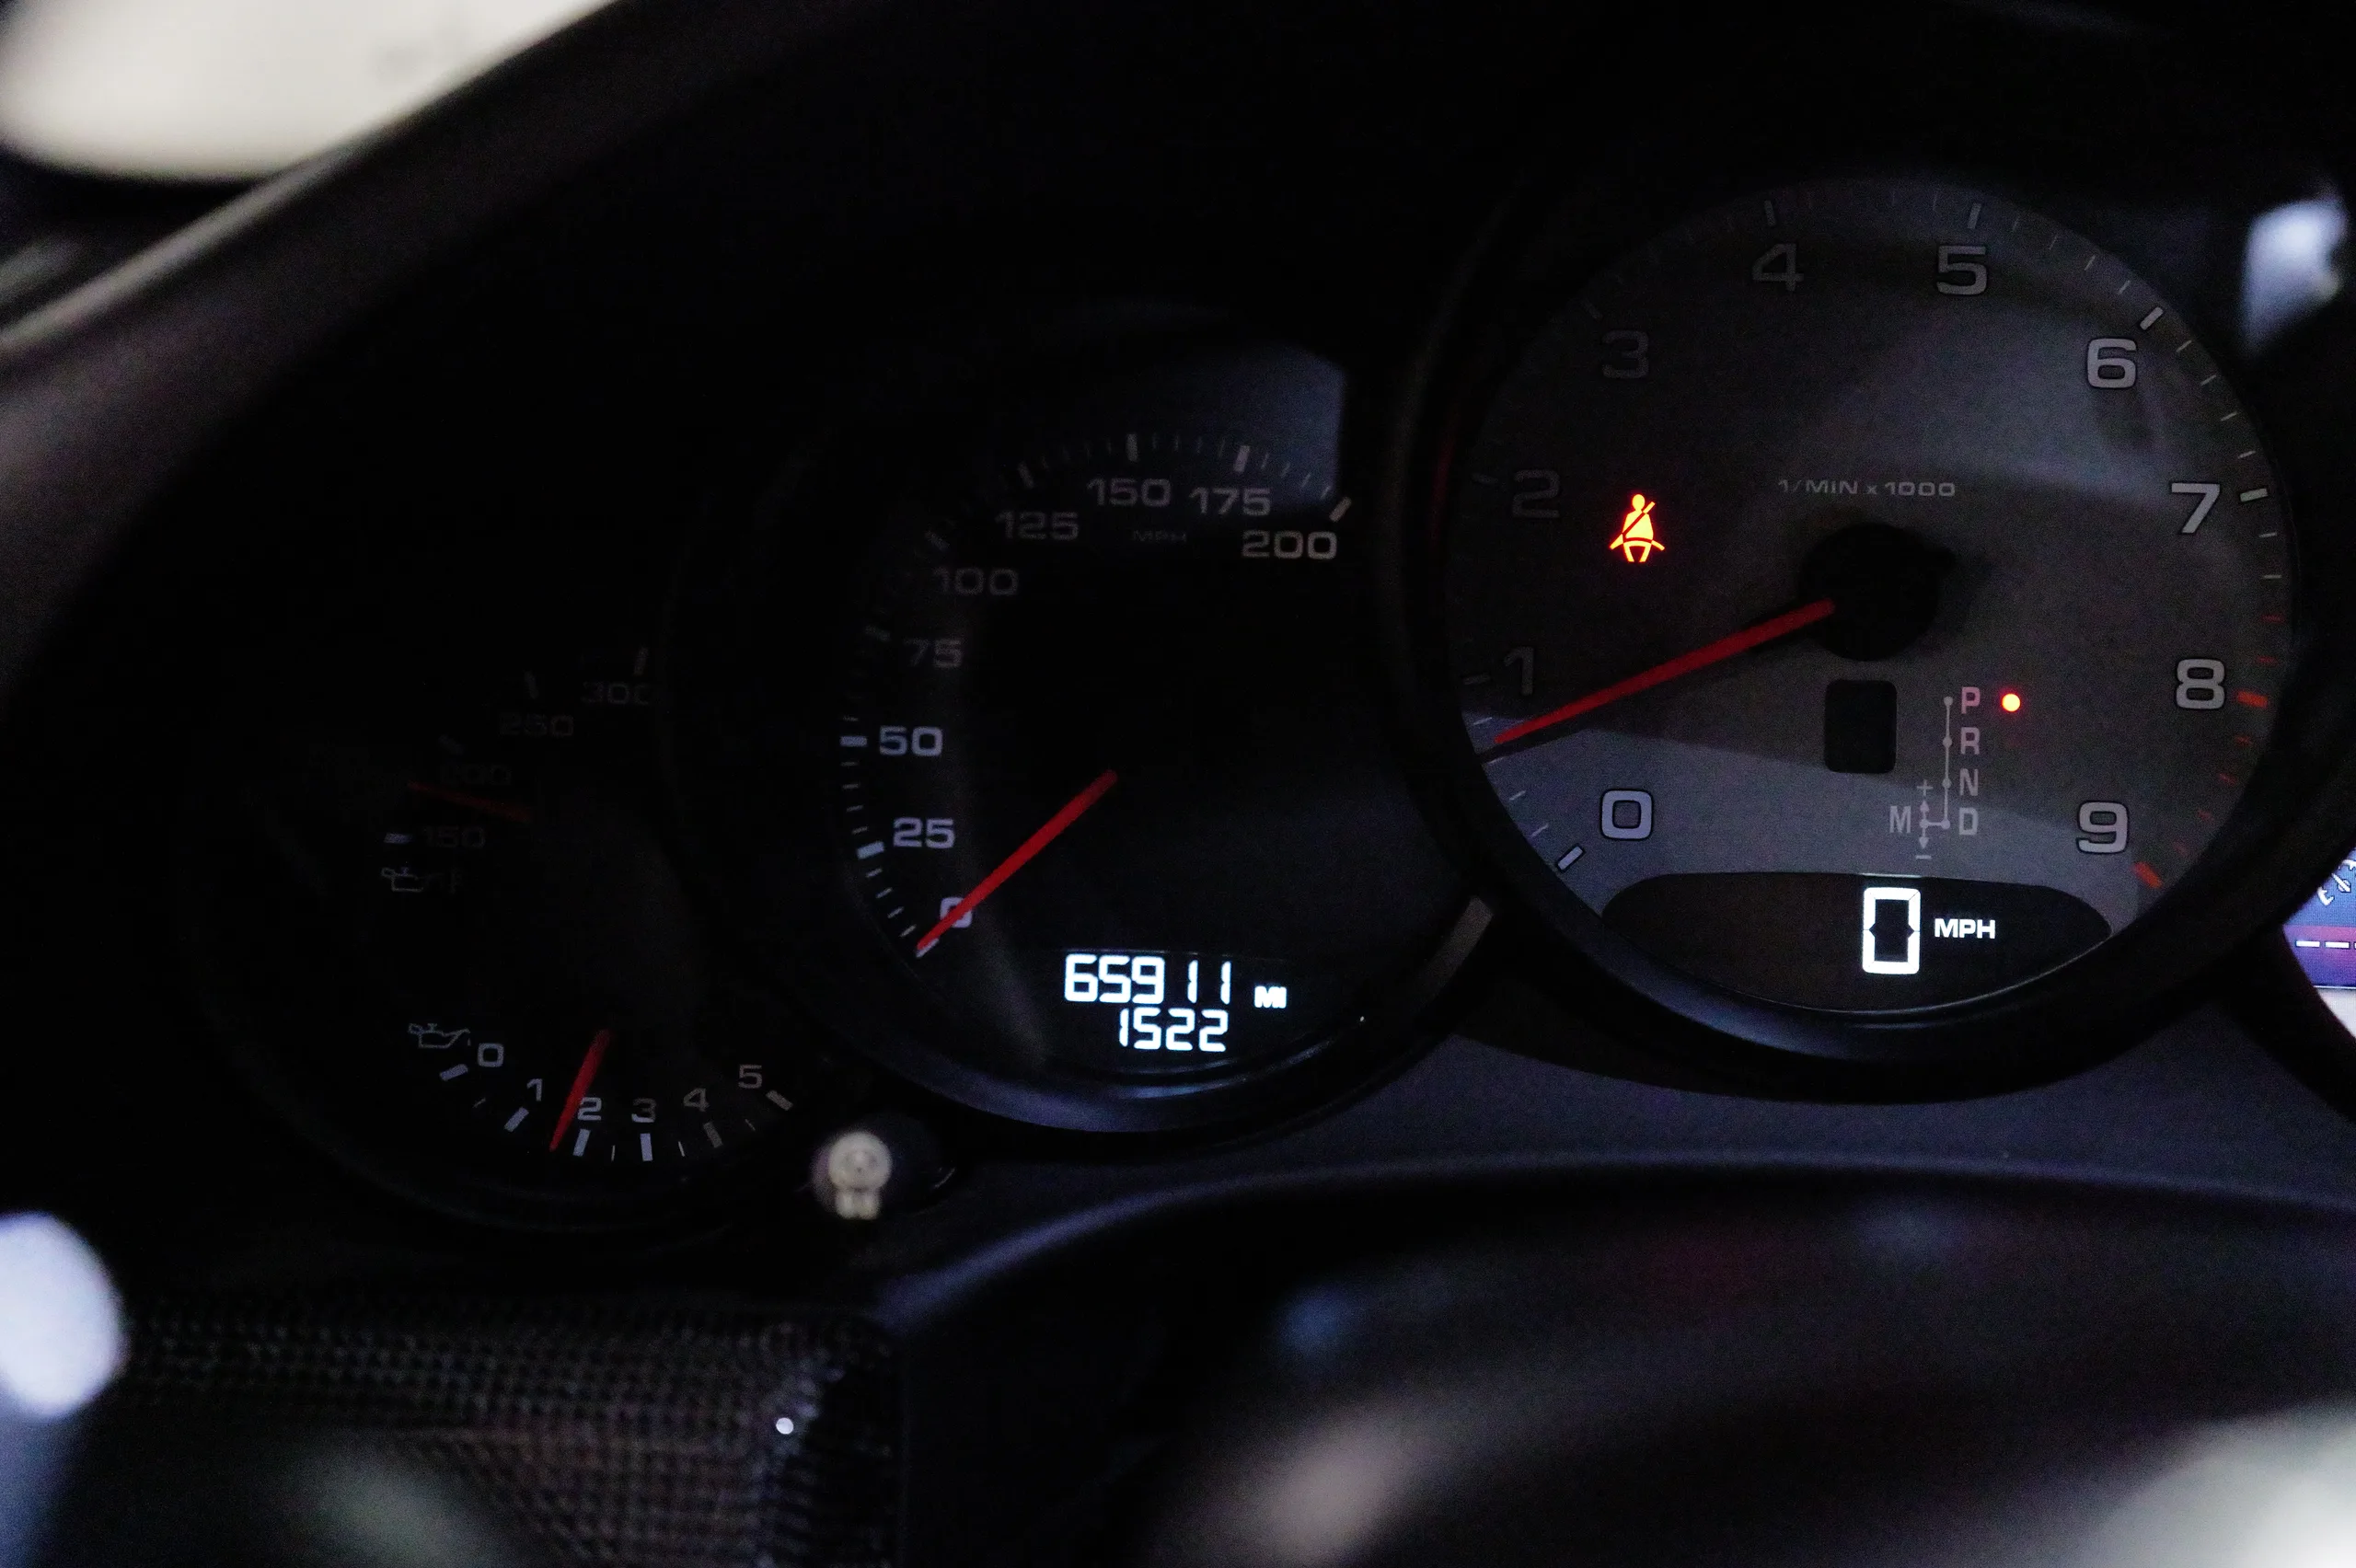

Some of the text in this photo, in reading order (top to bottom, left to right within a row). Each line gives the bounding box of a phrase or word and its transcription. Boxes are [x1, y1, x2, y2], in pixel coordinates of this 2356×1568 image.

[1752, 243, 1804, 292] 4
[1936, 245, 1989, 296] 5
[1601, 329, 1650, 379] 3
[2087, 338, 2138, 389] 6
[1087, 478, 1171, 507] 150
[1189, 487, 1271, 516] 175
[1512, 468, 1561, 519] 2
[1778, 478, 1858, 495] 1/MIN
[1885, 480, 1956, 497] 1000
[2171, 482, 2221, 534] 7
[995, 512, 1080, 541] 125
[1131, 529, 1187, 543] MPH
[1242, 529, 1337, 559] 200
[932, 566, 1019, 595] 100
[905, 639, 964, 669] 75
[1502, 646, 1534, 696] 1
[2176, 658, 2226, 710] 8
[1961, 686, 1981, 714] P
[879, 726, 942, 756] 50
[1960, 727, 1980, 755] R
[1959, 768, 1979, 796] N
[1600, 789, 1654, 840] 0
[1889, 805, 1911, 833] M
[1958, 807, 1979, 835] D
[2077, 801, 2130, 853] 9
[893, 818, 954, 848] 25
[1862, 887, 1996, 974] 0 MPH
[1064, 953, 1288, 1009] 65911 MI
[1118, 1007, 1230, 1052] 1522
[477, 1043, 505, 1067] 0
[526, 1078, 544, 1102] 1
[738, 1065, 763, 1090] 5
[578, 1097, 603, 1122] 2
[631, 1098, 657, 1124] 3
[683, 1088, 709, 1113] 4
